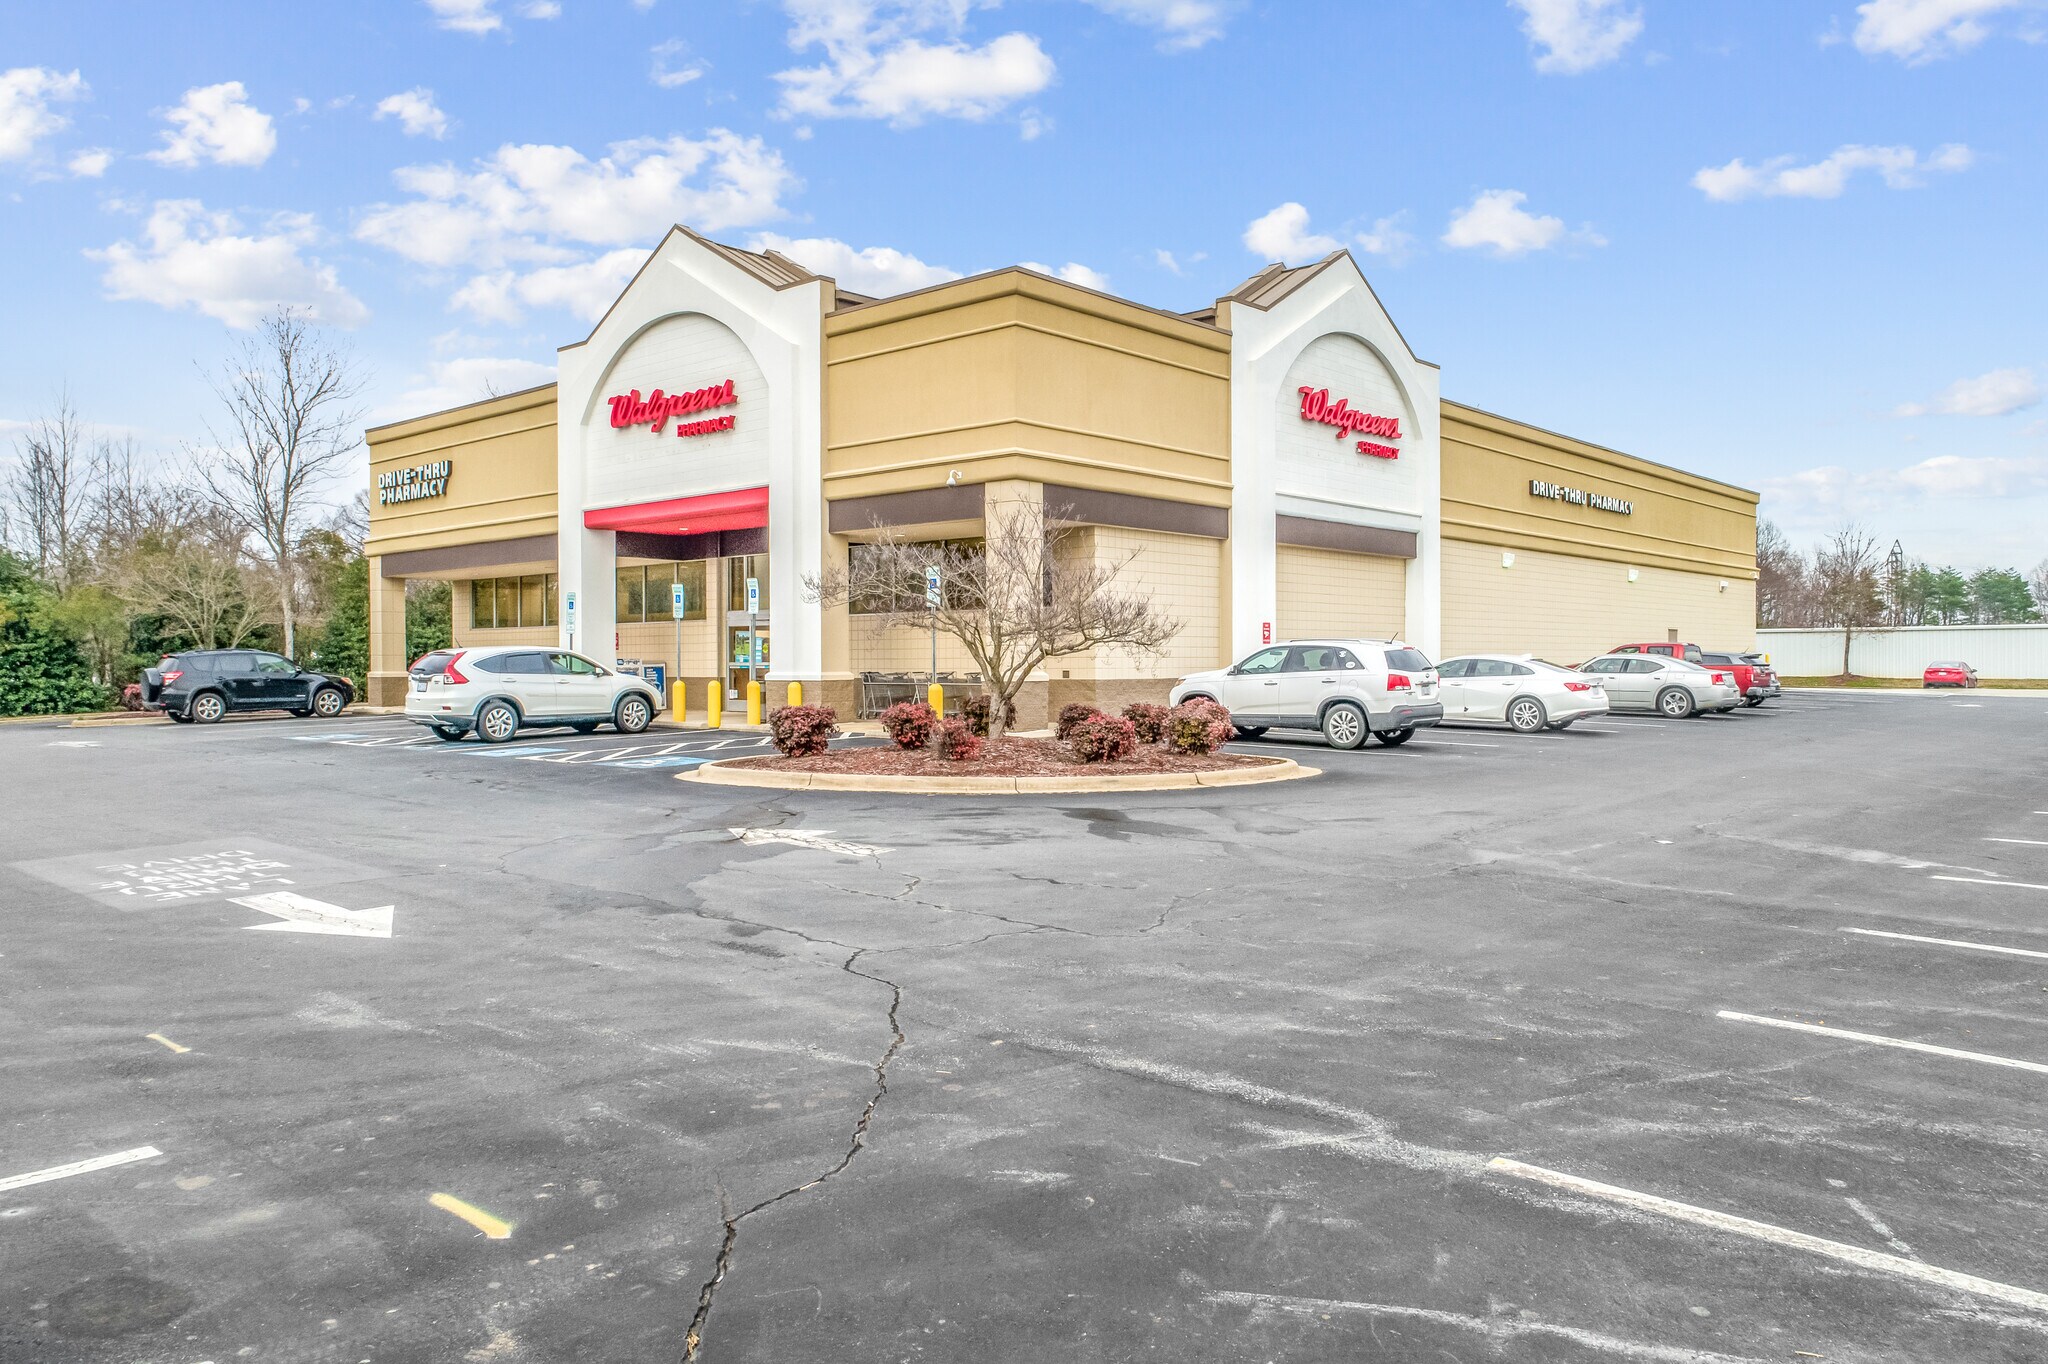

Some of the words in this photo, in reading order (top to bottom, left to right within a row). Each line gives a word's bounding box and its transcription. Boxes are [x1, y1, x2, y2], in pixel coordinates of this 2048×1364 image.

[608, 379, 738, 432] Walgreens
[1298, 386, 1402, 439] Walgreens
[677, 415, 736, 437] PHARMACY
[1358, 441, 1400, 460] PHARMACY
[378, 460, 450, 489] DRIVE-THRU
[380, 478, 447, 505] PHARMACY
[1530, 480, 1587, 505] DRIVE-THRU
[1589, 493, 1634, 515] PHARMACY
